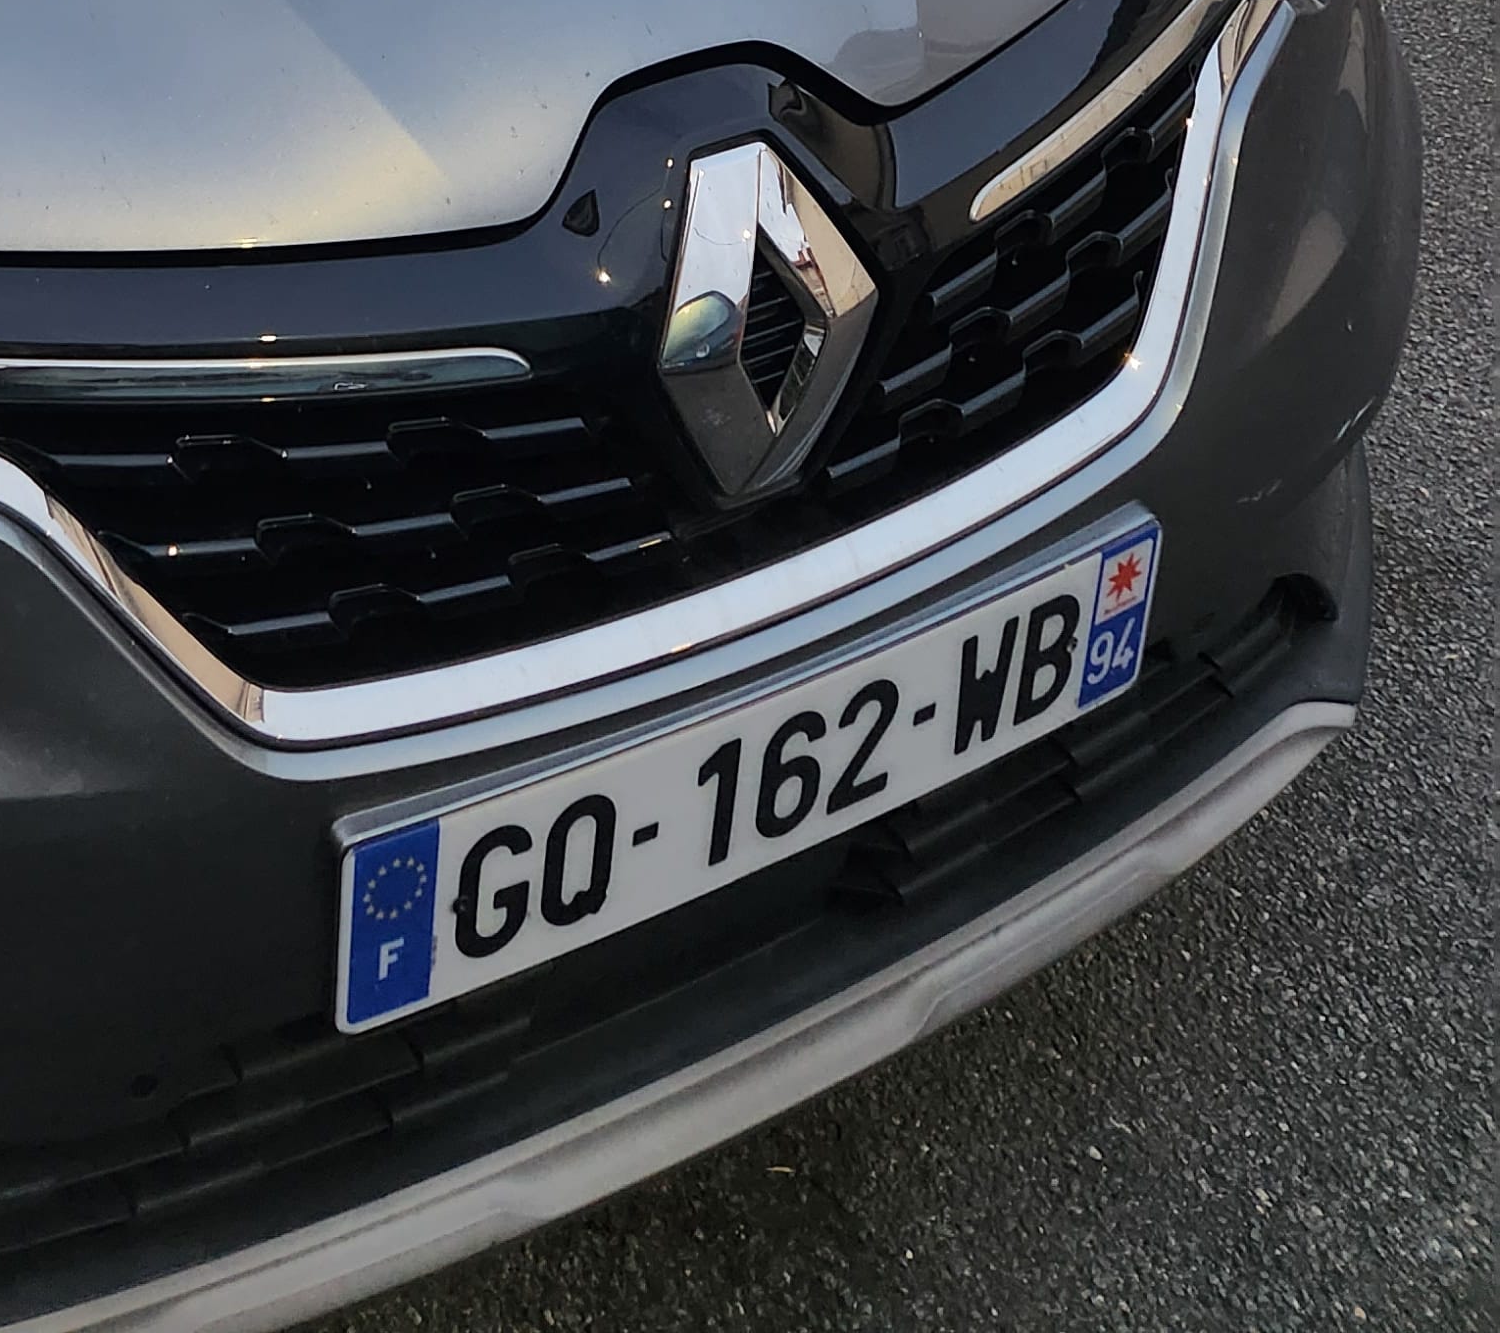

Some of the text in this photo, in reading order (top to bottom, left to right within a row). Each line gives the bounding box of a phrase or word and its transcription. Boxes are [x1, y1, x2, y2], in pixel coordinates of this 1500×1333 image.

[379, 595, 1135, 981] F GQ-162-WB 94
